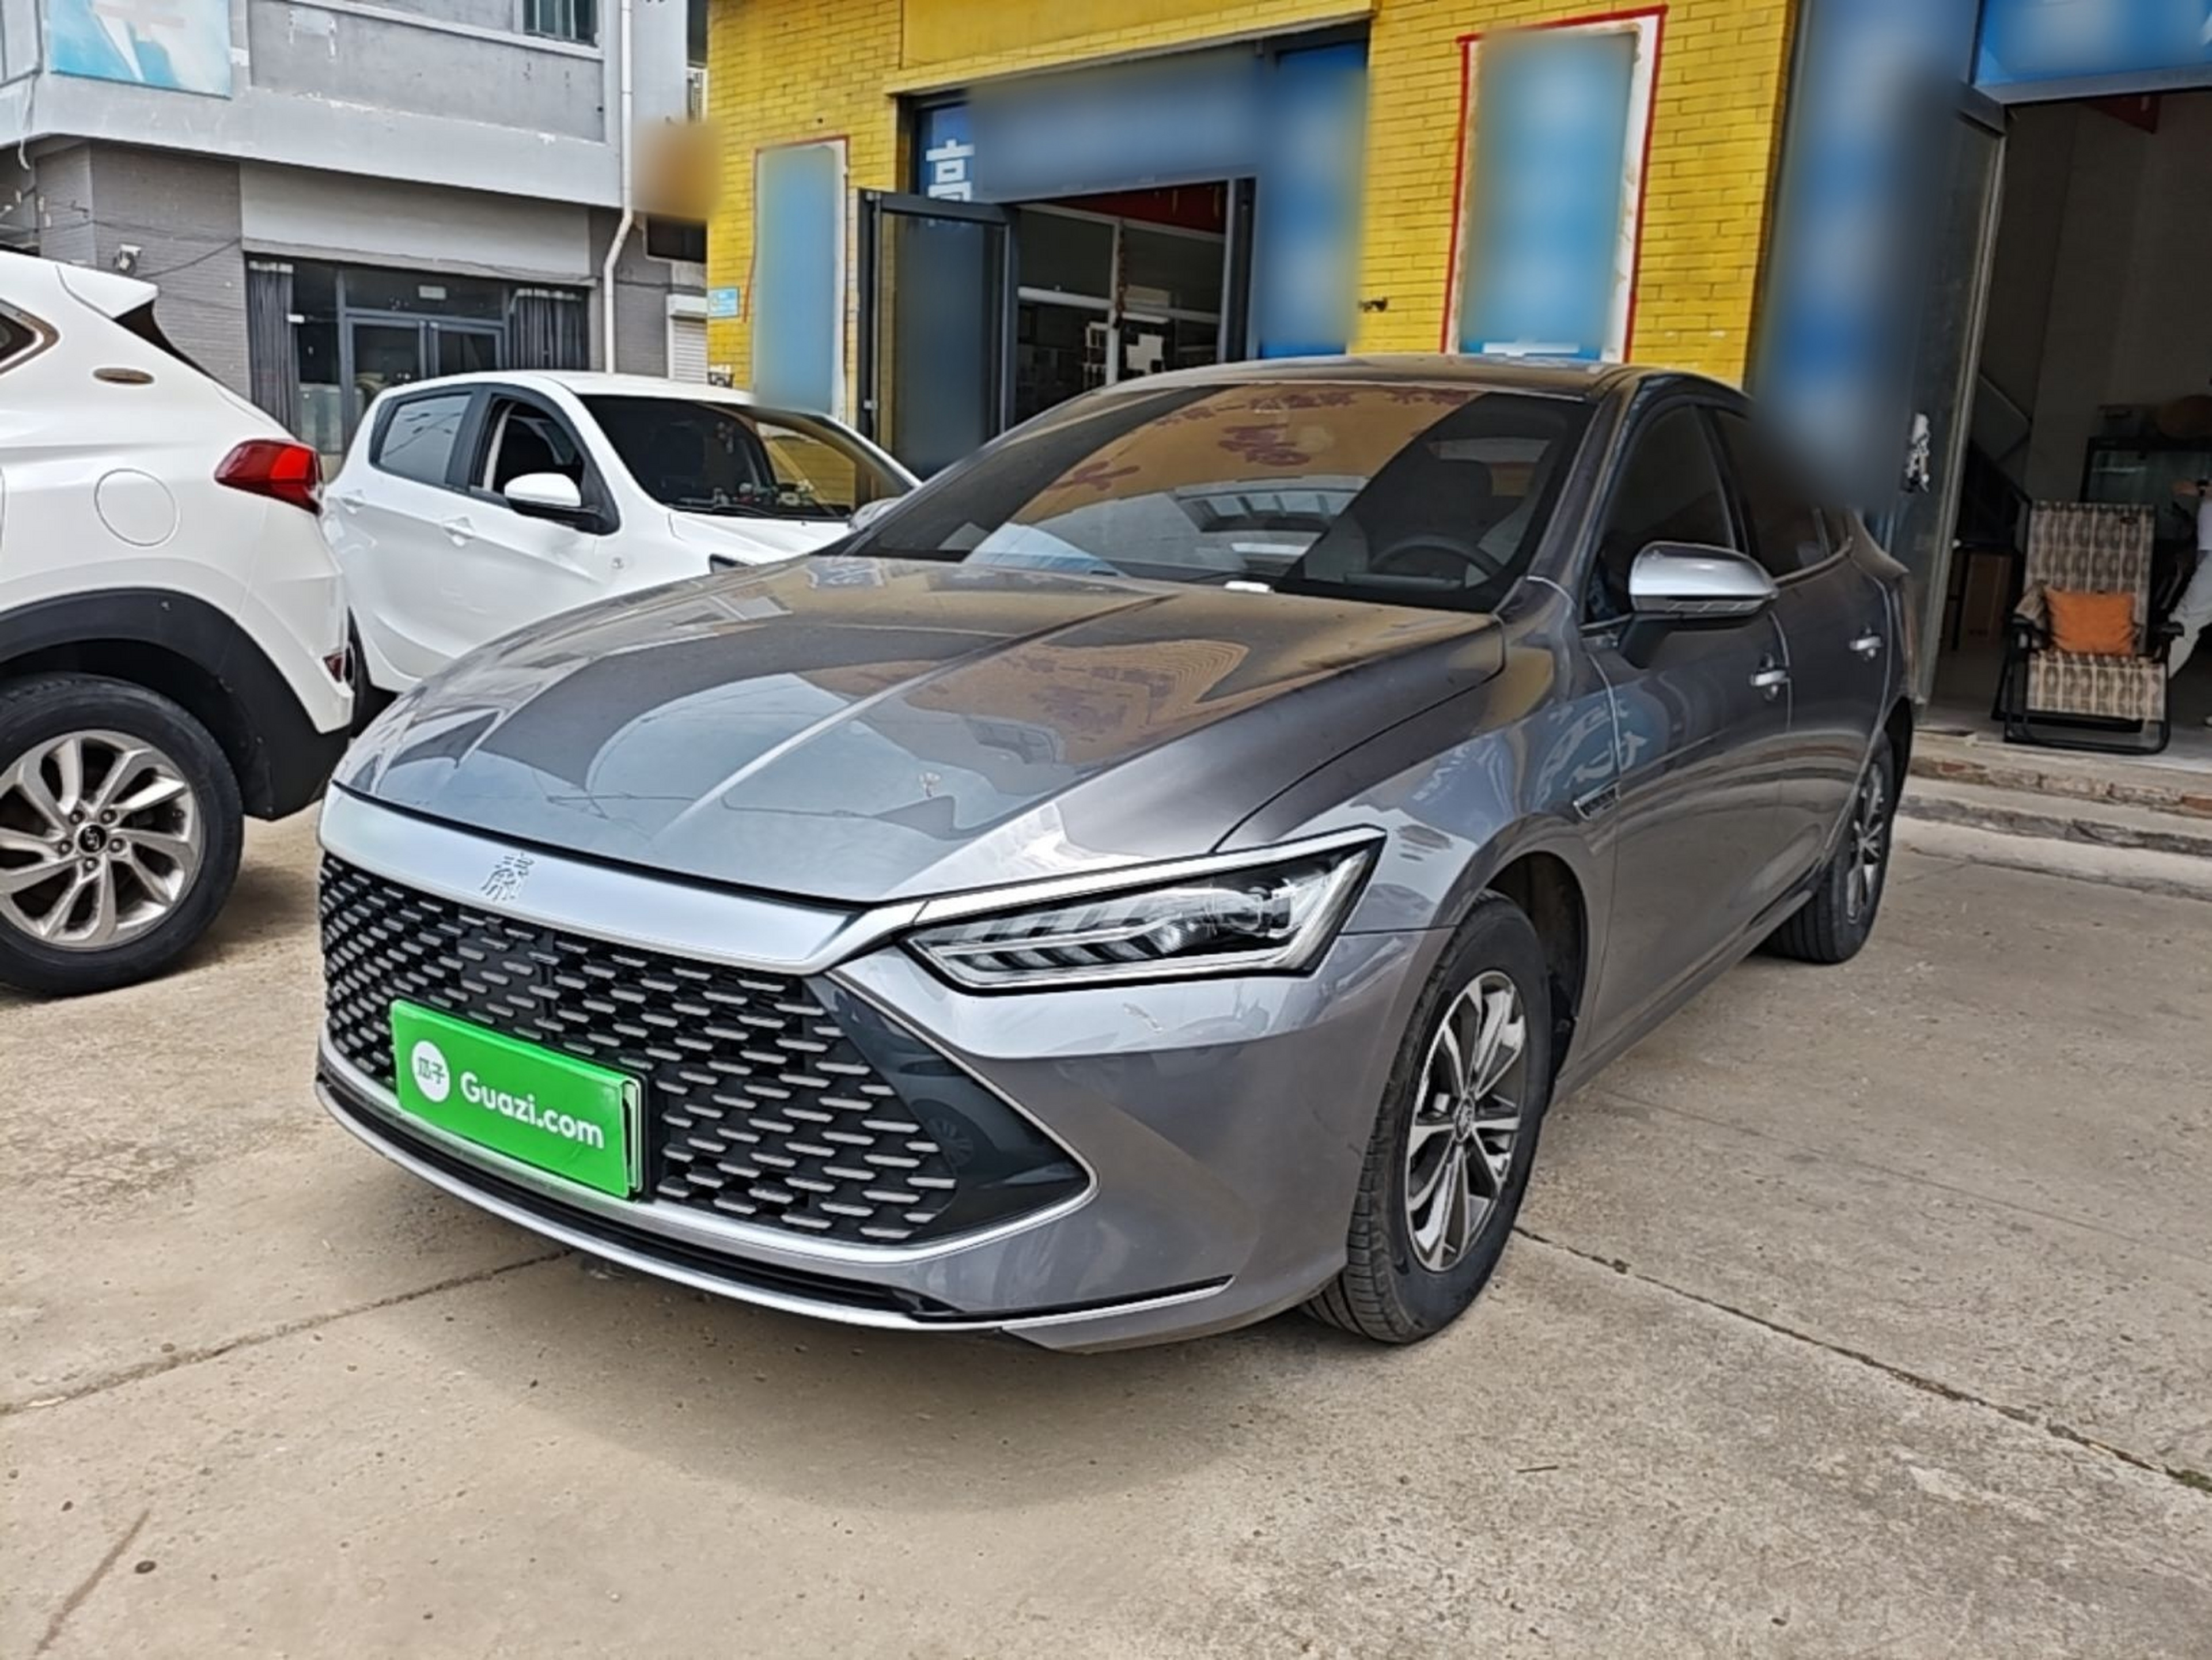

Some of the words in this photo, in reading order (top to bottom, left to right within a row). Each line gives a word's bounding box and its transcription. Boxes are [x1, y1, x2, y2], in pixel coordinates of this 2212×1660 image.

[926, 138, 975, 202] 高
[418, 1056, 446, 1084] 瓜子
[460, 1071, 604, 1149] Guazi.com
